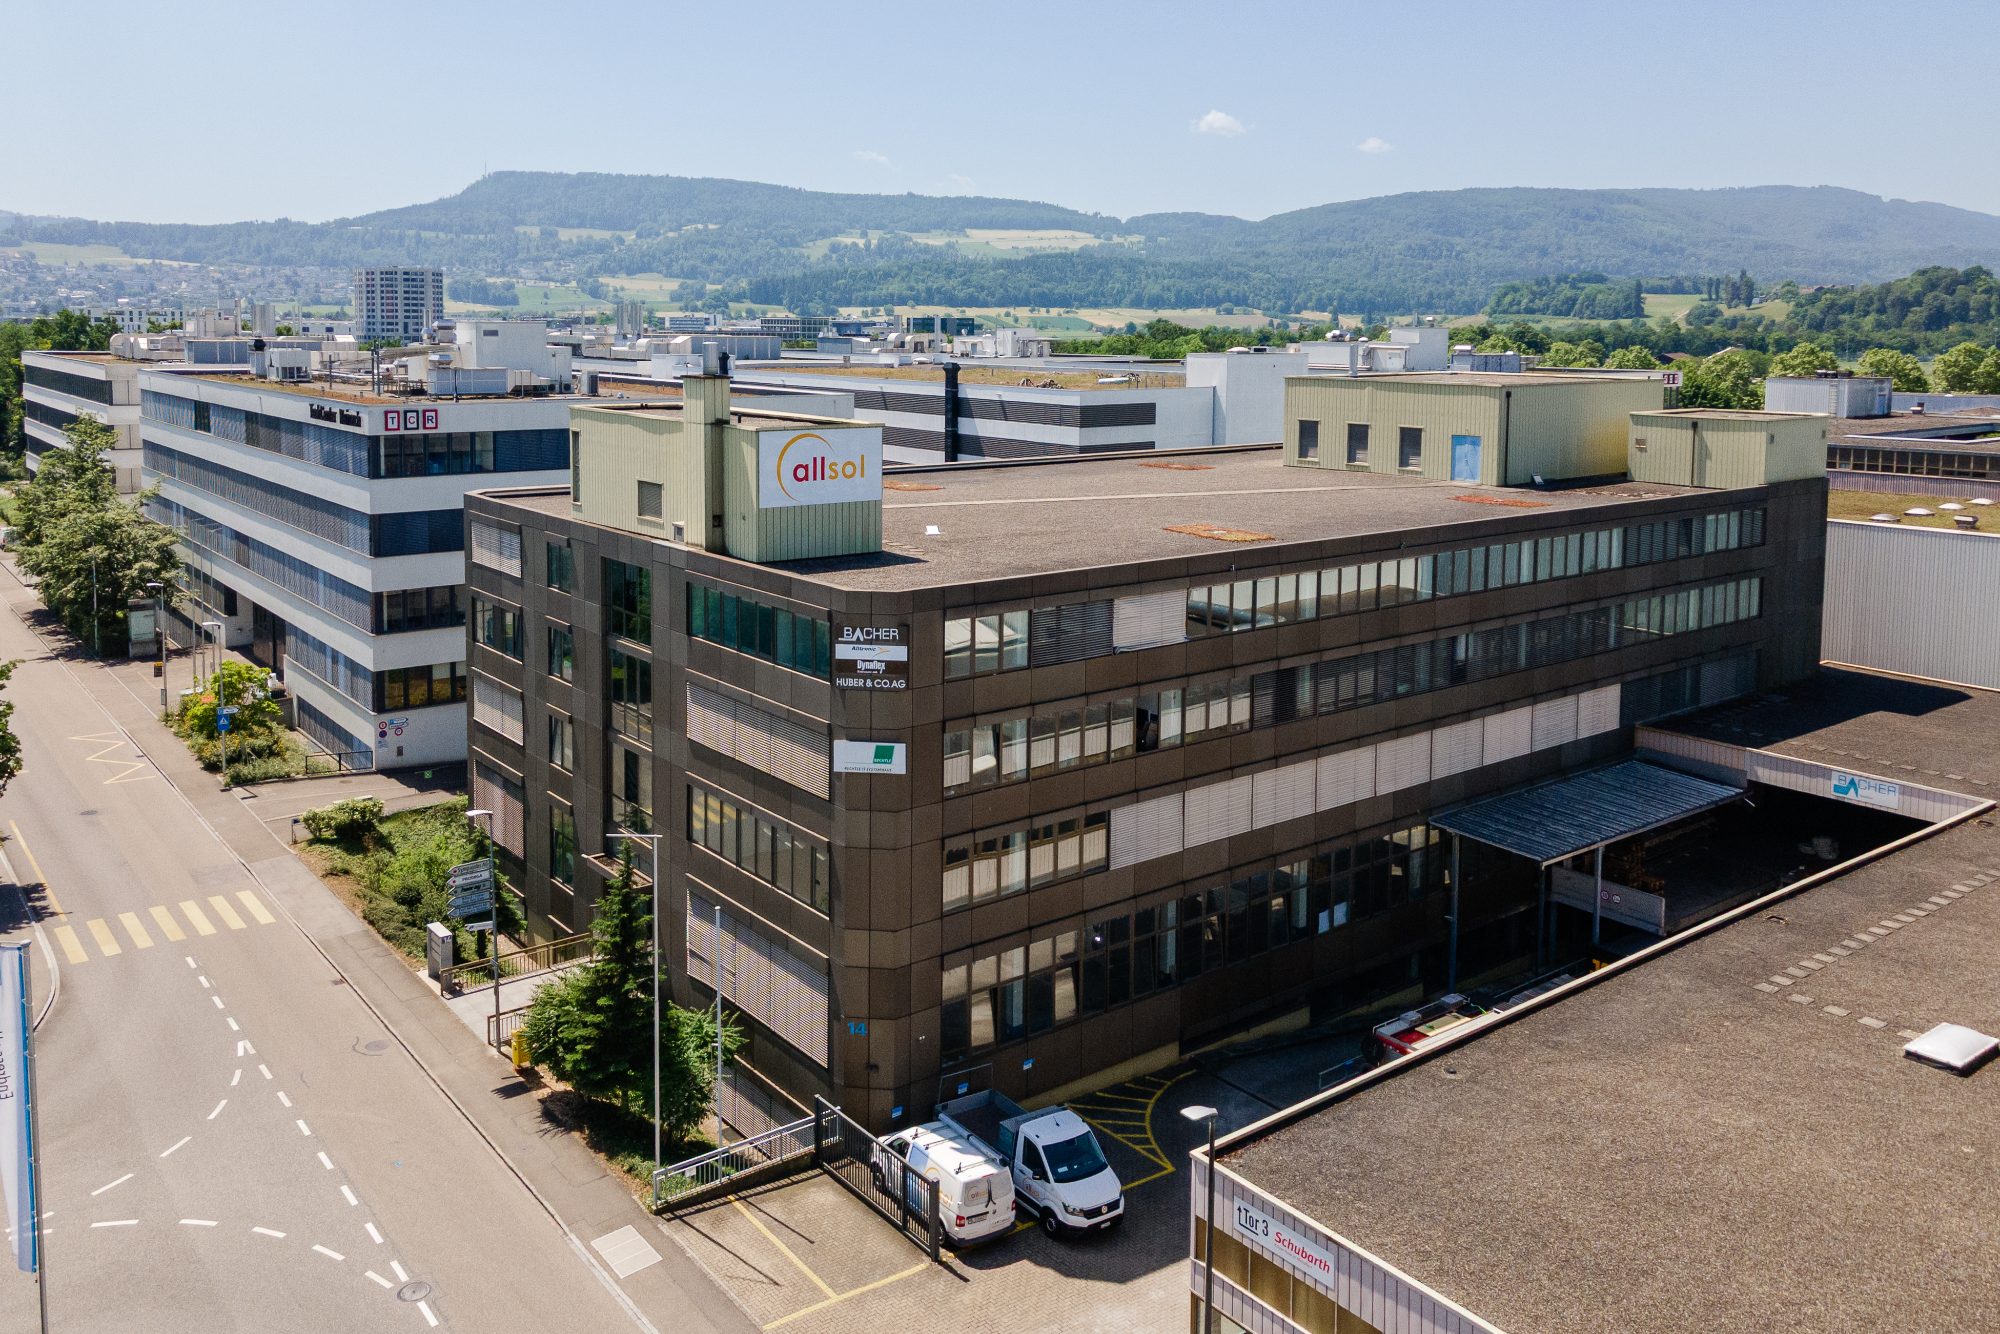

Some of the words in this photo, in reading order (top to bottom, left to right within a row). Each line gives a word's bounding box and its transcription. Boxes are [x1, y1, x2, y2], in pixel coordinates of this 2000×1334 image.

[792, 454, 865, 483] allsol
[839, 626, 899, 641] BACHER
[857, 660, 885, 674] Dynaflex
[836, 677, 864, 687] HUBER
[865, 678, 873, 688] &
[1834, 774, 1897, 798] BACHER
[848, 1021, 867, 1036] 14
[1243, 1207, 1259, 1231] Tor
[1262, 1219, 1269, 1237] 3
[1274, 1231, 1330, 1274] Schubarth
